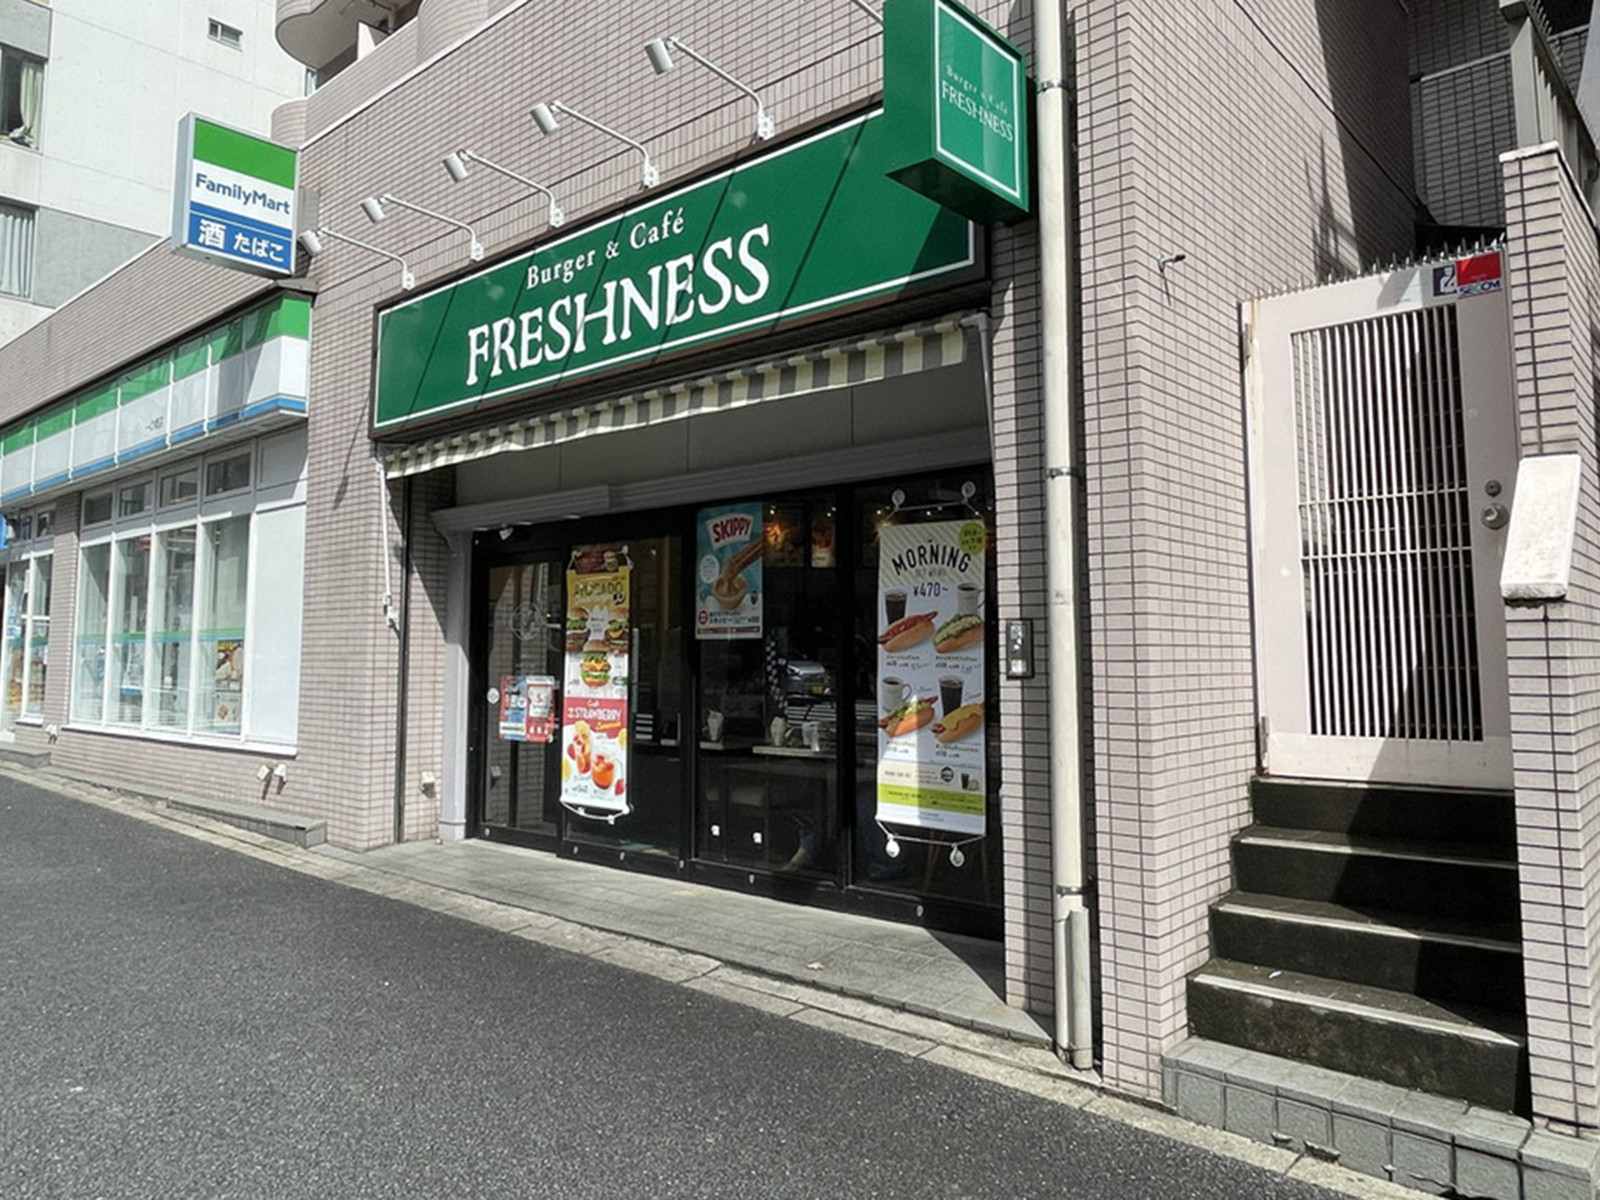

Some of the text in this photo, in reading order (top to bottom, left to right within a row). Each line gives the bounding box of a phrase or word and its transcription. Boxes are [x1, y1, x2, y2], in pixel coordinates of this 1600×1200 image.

[942, 80, 1013, 142] FRESHNESS
[195, 172, 290, 215] FamilyMart
[199, 218, 284, 262] 酒 たばこ
[526, 207, 685, 290] Burger & Café
[466, 223, 770, 387] FRESHNESS
[712, 516, 752, 543] SKIPPY
[891, 543, 971, 576] MORNING
